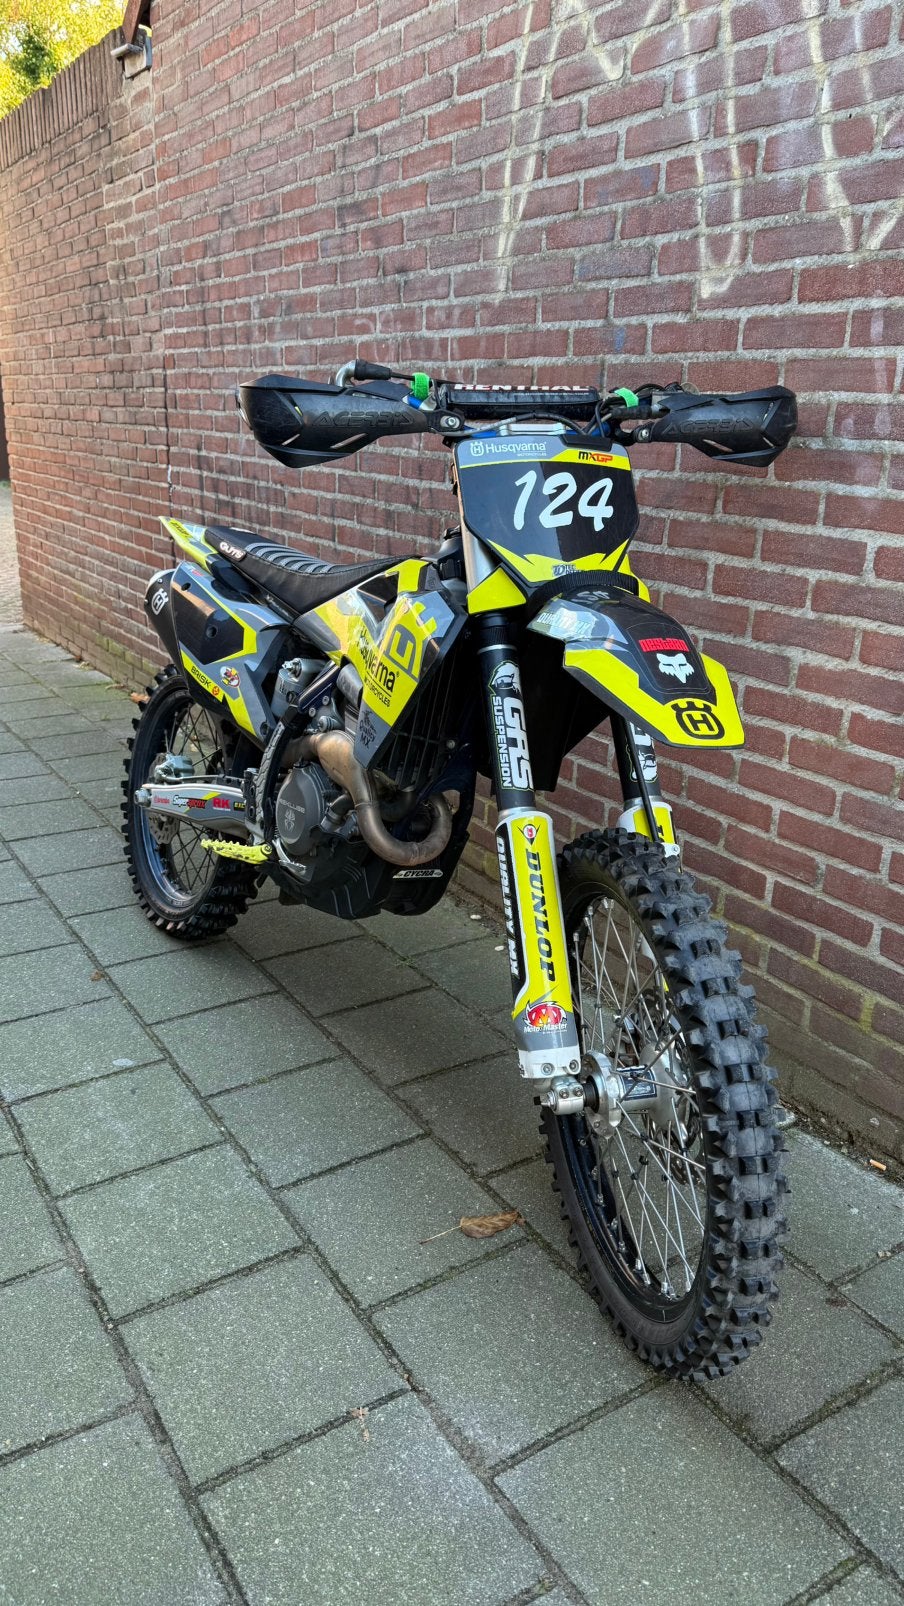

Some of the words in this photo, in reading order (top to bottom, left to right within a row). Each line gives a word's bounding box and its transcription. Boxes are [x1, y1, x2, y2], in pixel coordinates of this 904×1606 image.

[486, 442, 546, 454] Husqvarna
[578, 451, 613, 463] MXGP
[513, 470, 614, 532] 124
[219, 541, 245, 559] GUTS
[191, 666, 211, 688] BRISK
[493, 696, 512, 787] SUSPENSION
[503, 697, 534, 789] GRS
[213, 798, 231, 809] RK
[526, 848, 556, 982] DUNLOP
[543, 1023, 567, 1031] Master
